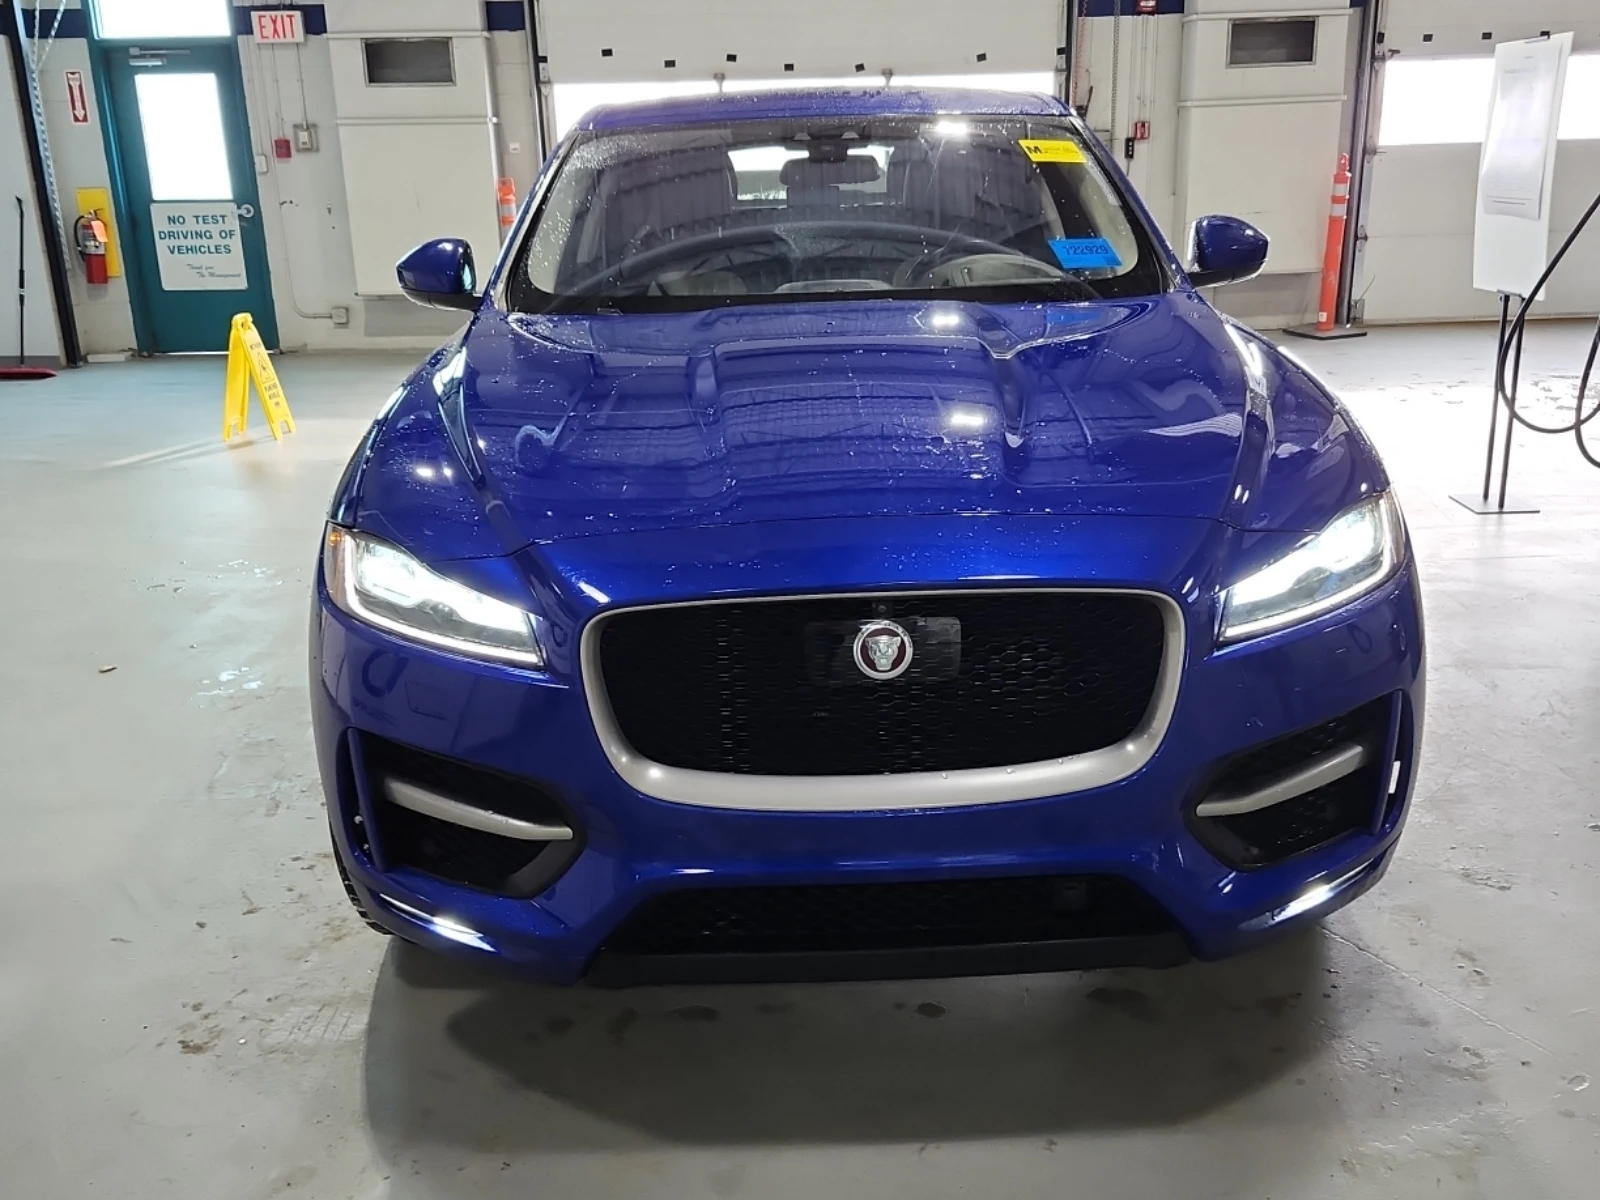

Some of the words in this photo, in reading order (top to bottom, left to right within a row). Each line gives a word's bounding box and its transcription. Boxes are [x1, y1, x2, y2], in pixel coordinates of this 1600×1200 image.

[258, 14, 295, 39] EXIT
[167, 215, 186, 225] NO
[192, 215, 227, 224] TEST
[158, 230, 214, 240] DRIVING
[219, 229, 236, 240] OF
[167, 244, 232, 255] VEHICLES
